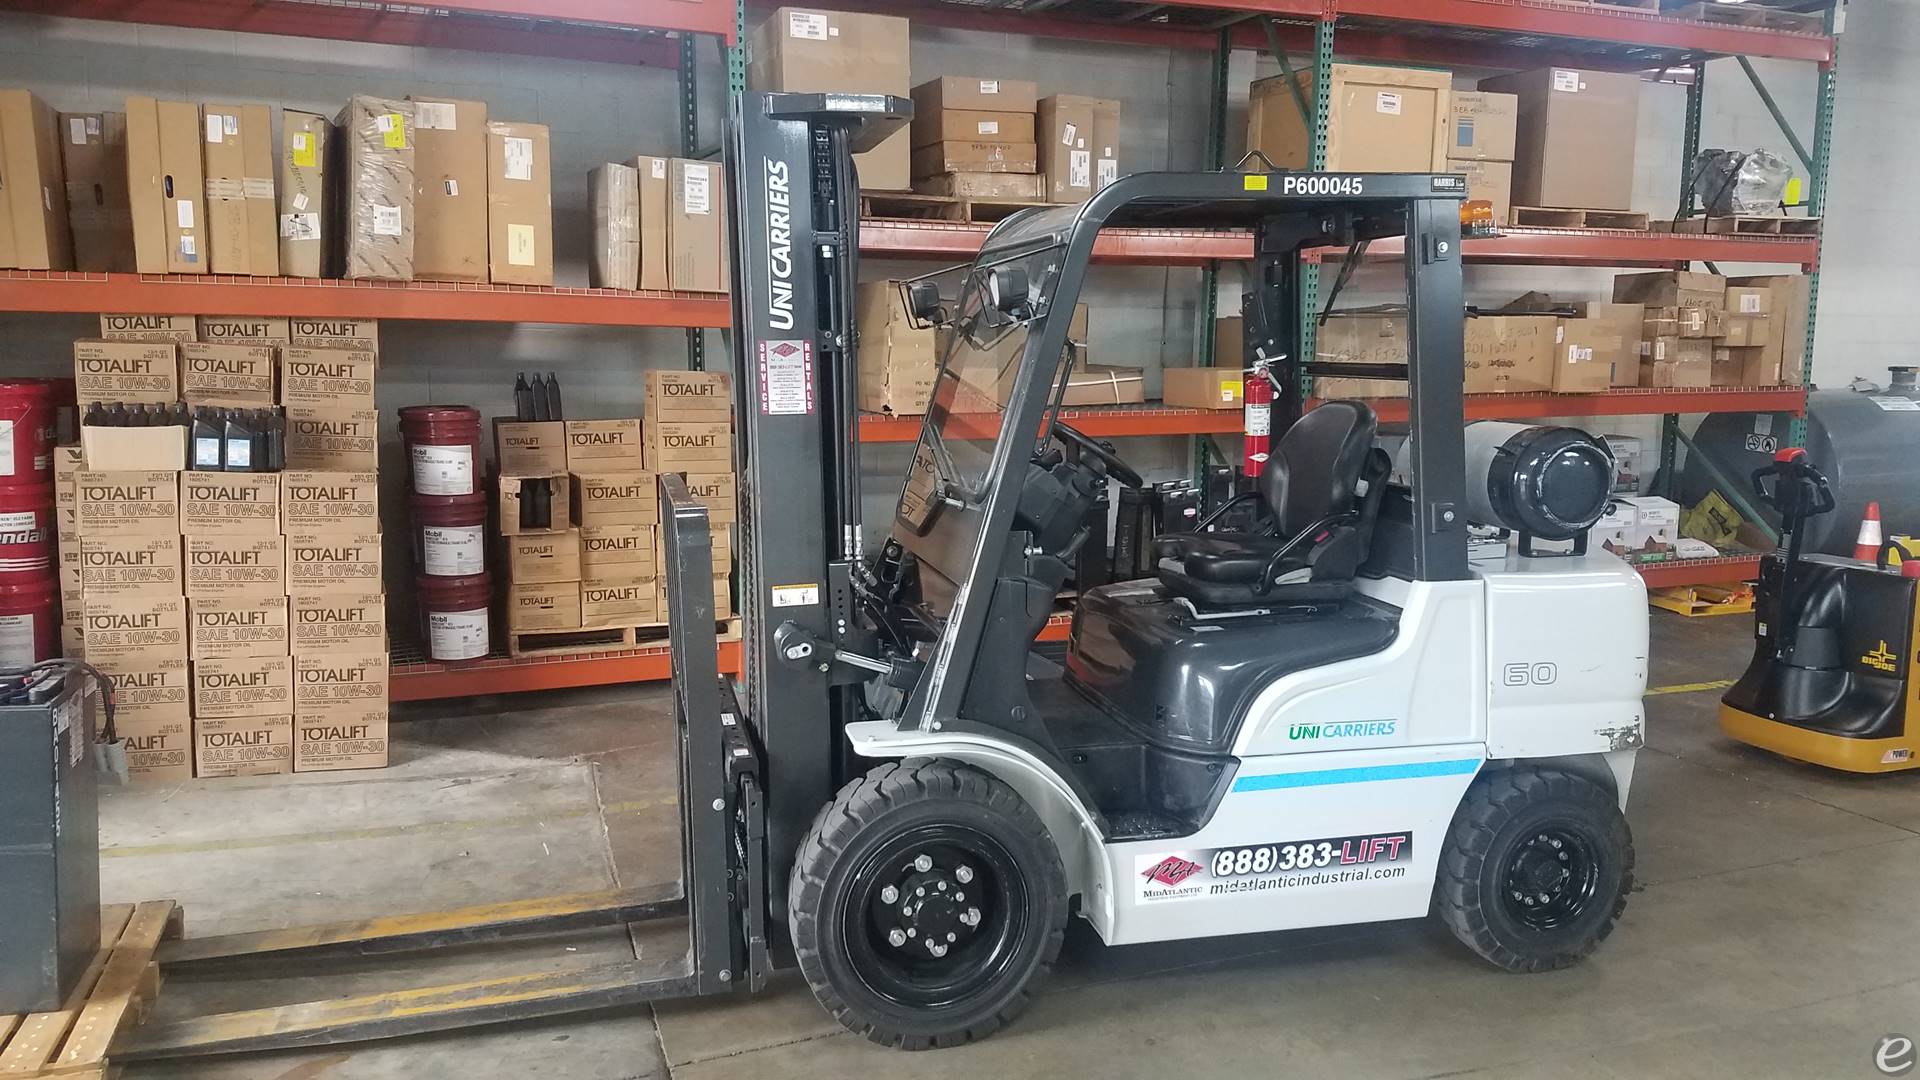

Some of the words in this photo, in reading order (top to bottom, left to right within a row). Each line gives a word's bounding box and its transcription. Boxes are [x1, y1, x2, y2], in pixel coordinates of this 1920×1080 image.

[1284, 176, 1362, 195] P600045
[105, 316, 173, 329] TOTALIFT
[294, 322, 357, 336] TOTALIFT
[204, 324, 269, 336] TOTALIFT
[80, 359, 152, 374] TOTALIFT
[187, 358, 255, 374] TOTALIFT
[289, 363, 355, 378] TOTALIFT
[80, 377, 112, 389] SAE
[116, 377, 171, 390] 10W-30
[186, 375, 216, 387] SAE
[760, 344, 768, 410] SERVICE
[288, 379, 317, 391] SAE
[321, 380, 371, 393] 10W-30
[662, 384, 715, 395] TOTALIFT
[293, 422, 358, 436] TOTALIFT
[325, 437, 374, 450] 10W-30
[505, 438, 539, 446] TOTALIFT
[570, 432, 623, 445] TOTALIFT
[663, 435, 716, 447] TOTALIFT
[82, 486, 156, 500] TOTALIFT
[188, 486, 259, 501] TOTALIFT
[289, 487, 358, 500] TOTALIFT
[586, 486, 640, 499] TOTALIFT
[82, 504, 114, 516] SAE
[119, 503, 175, 516] 10W-30
[187, 504, 218, 515] SAE
[223, 504, 277, 516] 10W-30
[289, 504, 318, 515] SAE
[323, 504, 375, 515] 10W-30
[0, 528, 46, 544] ndall
[518, 546, 553, 555] TOTALIFT
[583, 537, 638, 551] TOTALIFT
[83, 551, 156, 566] TOTALIFT
[190, 551, 260, 564] TOTALIFT
[294, 548, 362, 561] TOTALIFT
[83, 570, 115, 582] SAE
[120, 568, 175, 581] 10W-30
[190, 569, 220, 580] SAE
[226, 568, 278, 580] 10W-30
[293, 565, 322, 576] SAE
[327, 564, 378, 576] 10W-30
[520, 597, 553, 606] TOTALIFT
[584, 588, 639, 602] TOTALIFT
[88, 614, 161, 629] TOTALIFT
[198, 611, 267, 626] TOTALIFT
[298, 608, 365, 622] TOTALIFT
[197, 629, 228, 641] SAE
[232, 627, 285, 640] 10W-30
[297, 626, 326, 637] SAE
[331, 624, 382, 636] 10W-30
[88, 633, 120, 646] SAE
[125, 630, 180, 644] 10W-30
[107, 673, 166, 688] TALIFT
[200, 672, 269, 688] TOTALIFT
[299, 668, 366, 683] TOTALIFT
[1504, 662, 1557, 686] 60
[131, 688, 185, 702] 10W-30
[200, 691, 230, 704] SAE
[235, 688, 287, 702] 10W-30
[298, 686, 327, 698] SAE
[332, 684, 382, 697] 10W-30
[203, 730, 272, 747] TOTALIFT
[302, 725, 368, 741] TOTALIFT
[203, 750, 233, 762] SAE
[238, 746, 290, 760] 10W-30
[301, 743, 330, 756] SAE
[335, 740, 385, 754] 10W-30
[132, 752, 185, 766] 10W-30
[1210, 866, 1405, 895] midatlanticindustrial.com
